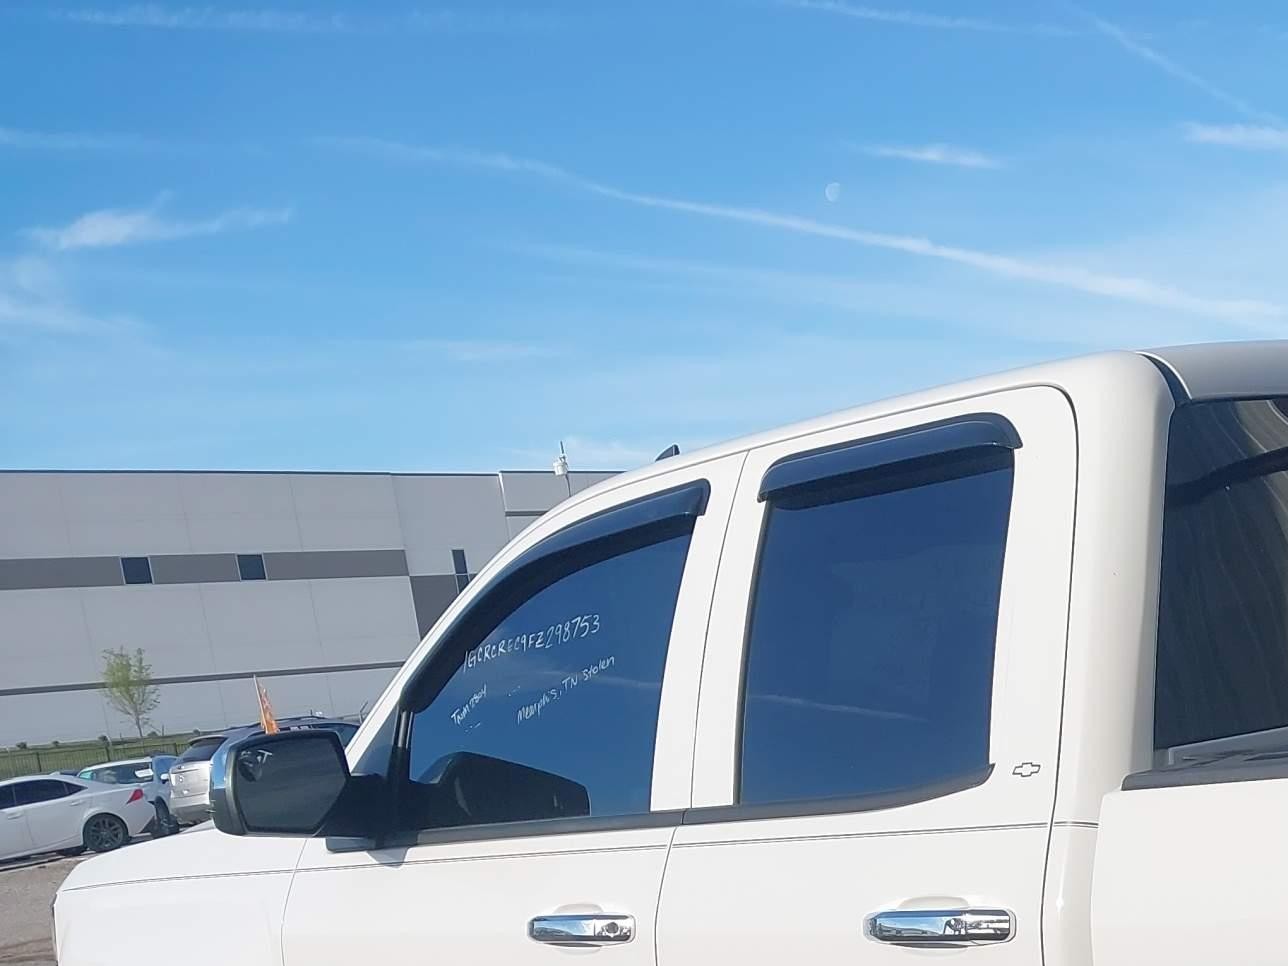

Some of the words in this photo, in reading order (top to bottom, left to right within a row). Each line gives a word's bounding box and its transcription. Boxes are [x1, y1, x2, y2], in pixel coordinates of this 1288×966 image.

[463, 614, 600, 673] 1GCRCREC9FZ298753
[562, 674, 579, 693] TN
[582, 656, 616, 681] Stolen
